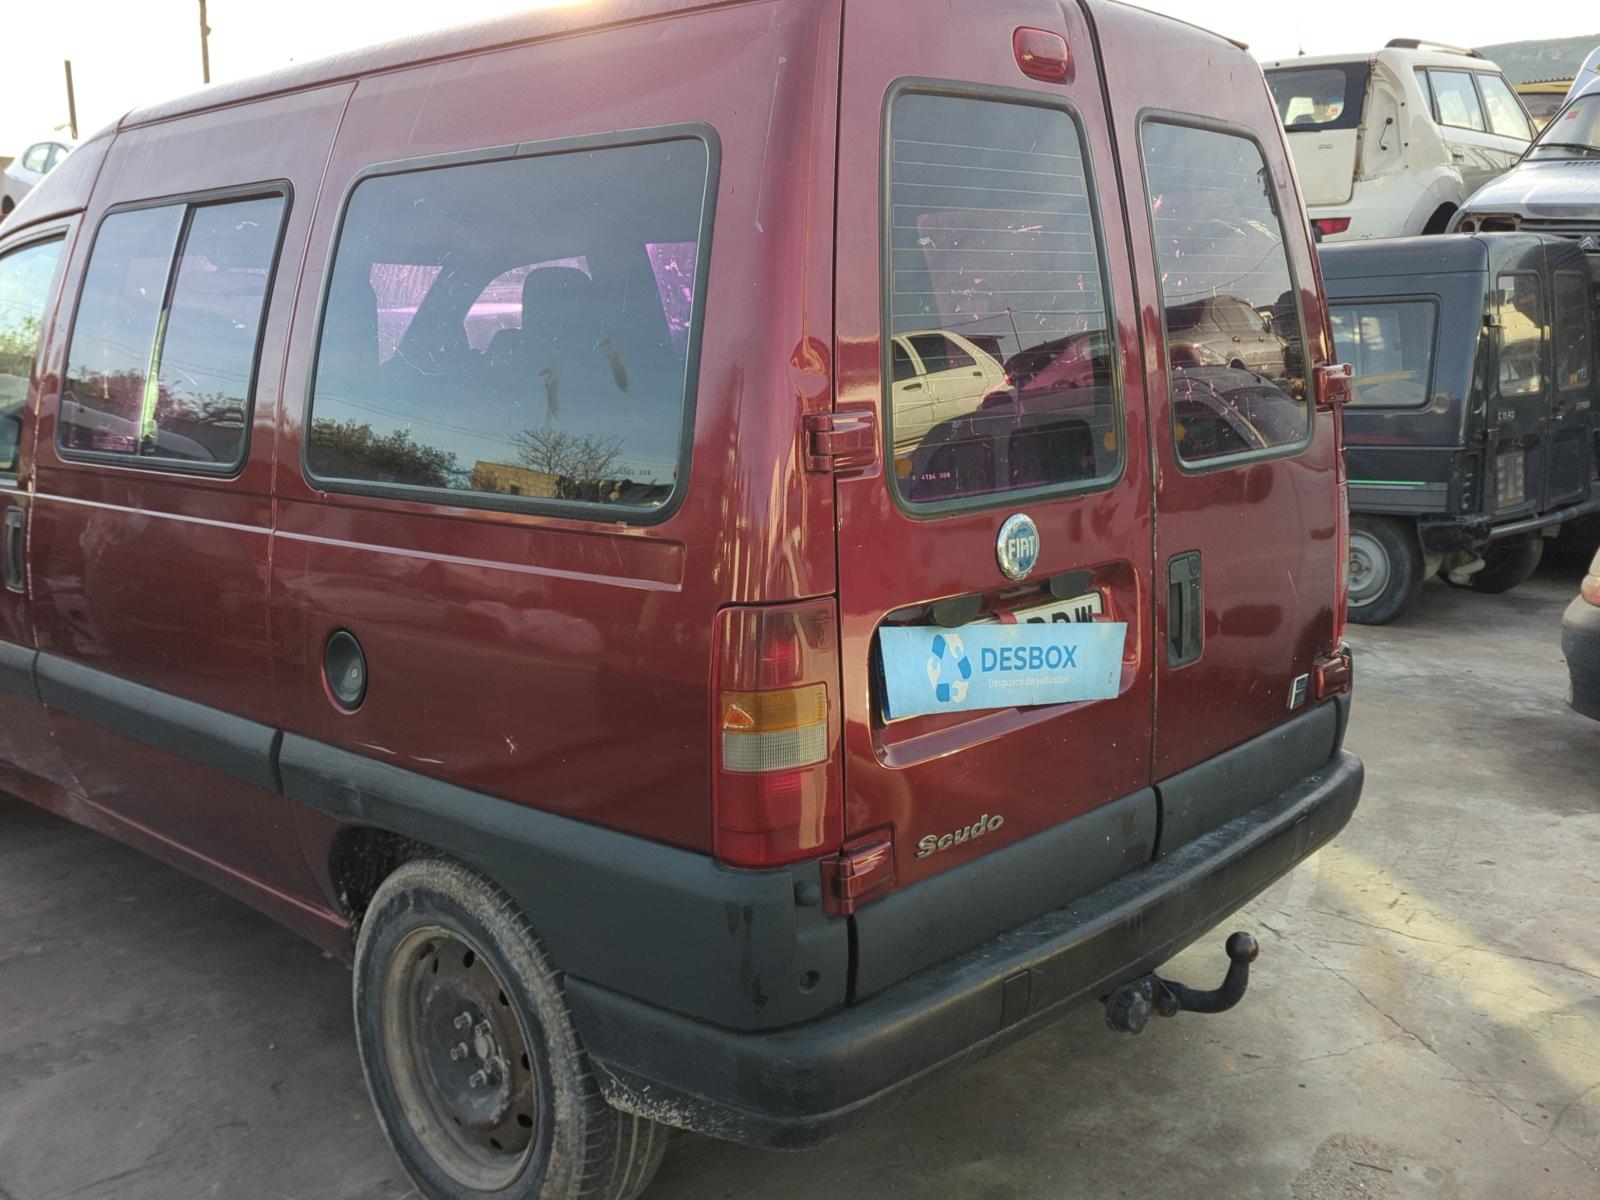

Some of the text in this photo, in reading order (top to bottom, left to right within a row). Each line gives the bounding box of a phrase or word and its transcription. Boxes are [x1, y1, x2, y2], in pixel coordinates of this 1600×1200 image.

[1008, 535, 1035, 560] FIAT
[981, 645, 1078, 672] DESBOX
[987, 678, 1024, 688] Desguace
[1025, 677, 1034, 686] de
[915, 813, 1004, 858] Scudo
